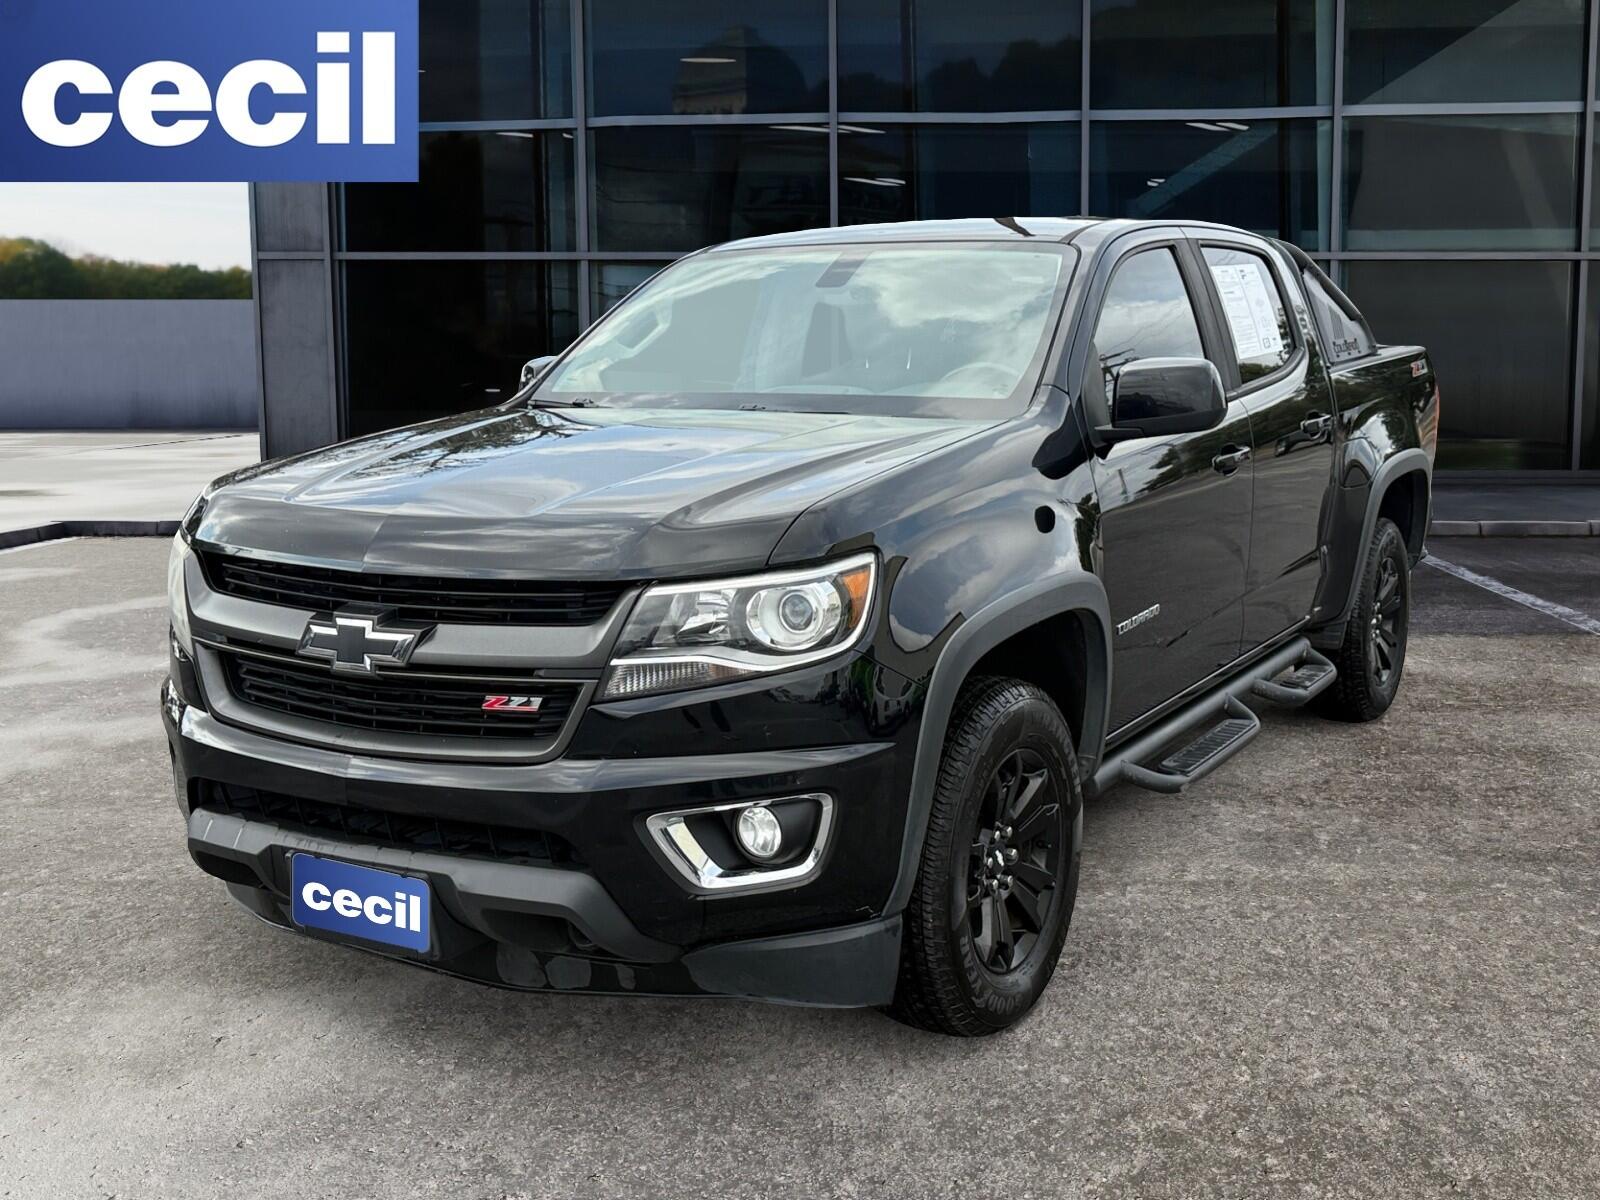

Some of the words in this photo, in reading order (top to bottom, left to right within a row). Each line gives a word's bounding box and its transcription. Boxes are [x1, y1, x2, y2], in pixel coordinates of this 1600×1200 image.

[1117, 603, 1160, 635] COLORADO
[481, 695, 543, 712] Z71
[302, 881, 421, 932] cecil
